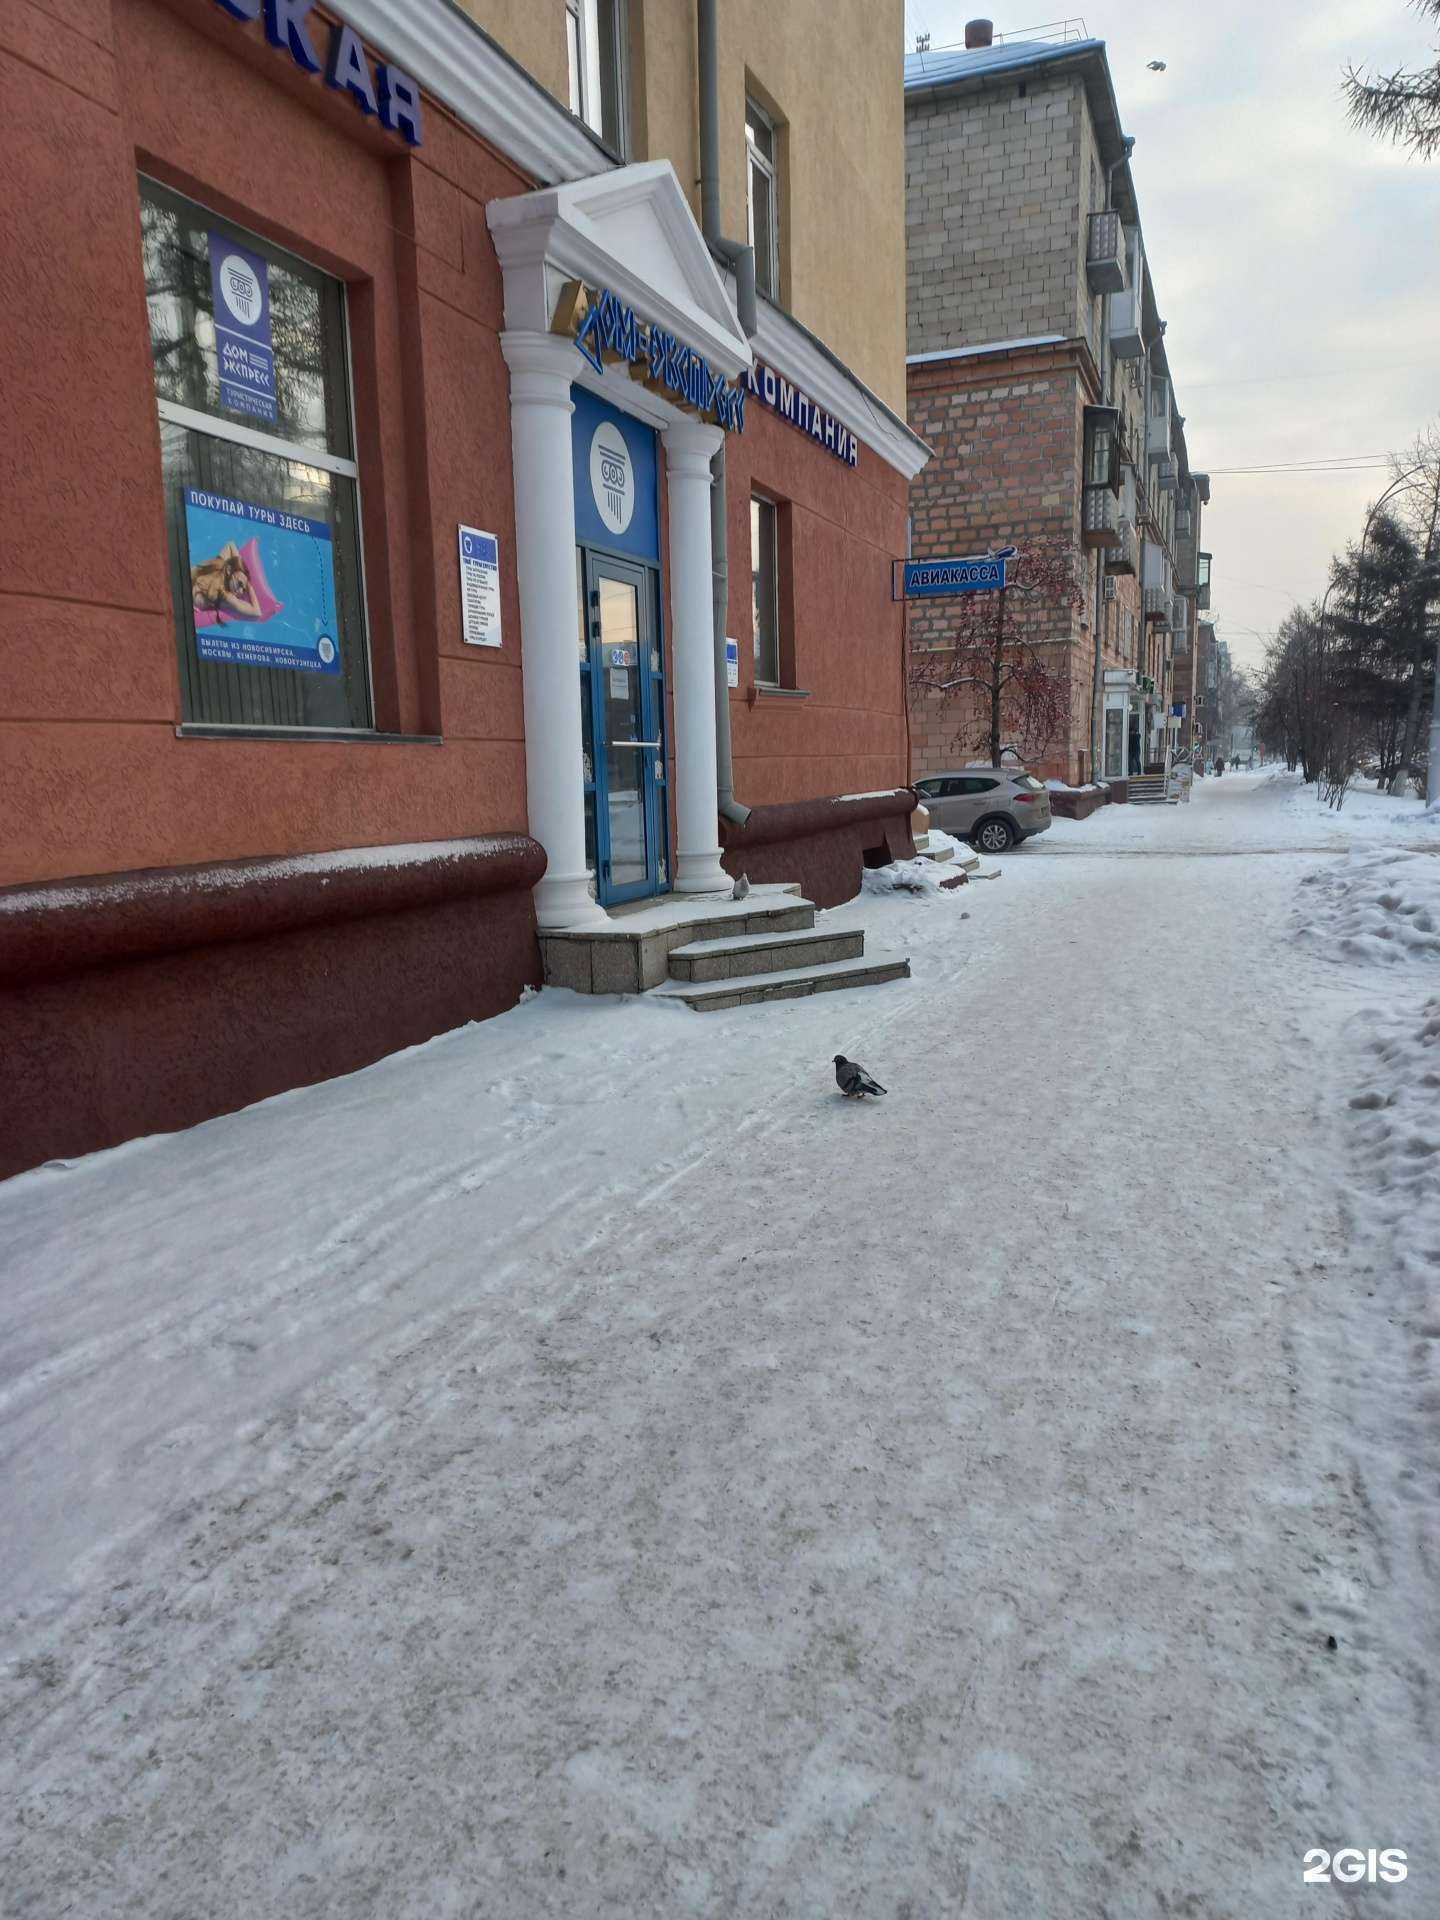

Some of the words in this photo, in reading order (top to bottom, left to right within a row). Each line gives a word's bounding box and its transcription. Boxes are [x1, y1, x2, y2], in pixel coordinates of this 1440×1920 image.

[212, 0, 423, 146] КАЯ
[222, 341, 249, 364] ДОМ
[222, 356, 271, 387] ЭКСПРЕСС
[746, 357, 859, 468] КОМПАНИЯ
[190, 490, 244, 516] ПОКУПАЙ
[248, 505, 276, 525] ТУРЫ
[279, 514, 310, 533] ЗДЕСЬ
[910, 564, 999, 587] АВИАКАССА
[201, 637, 229, 649] ВЫЛЕТЫ
[231, 641, 240, 650] ИЗ
